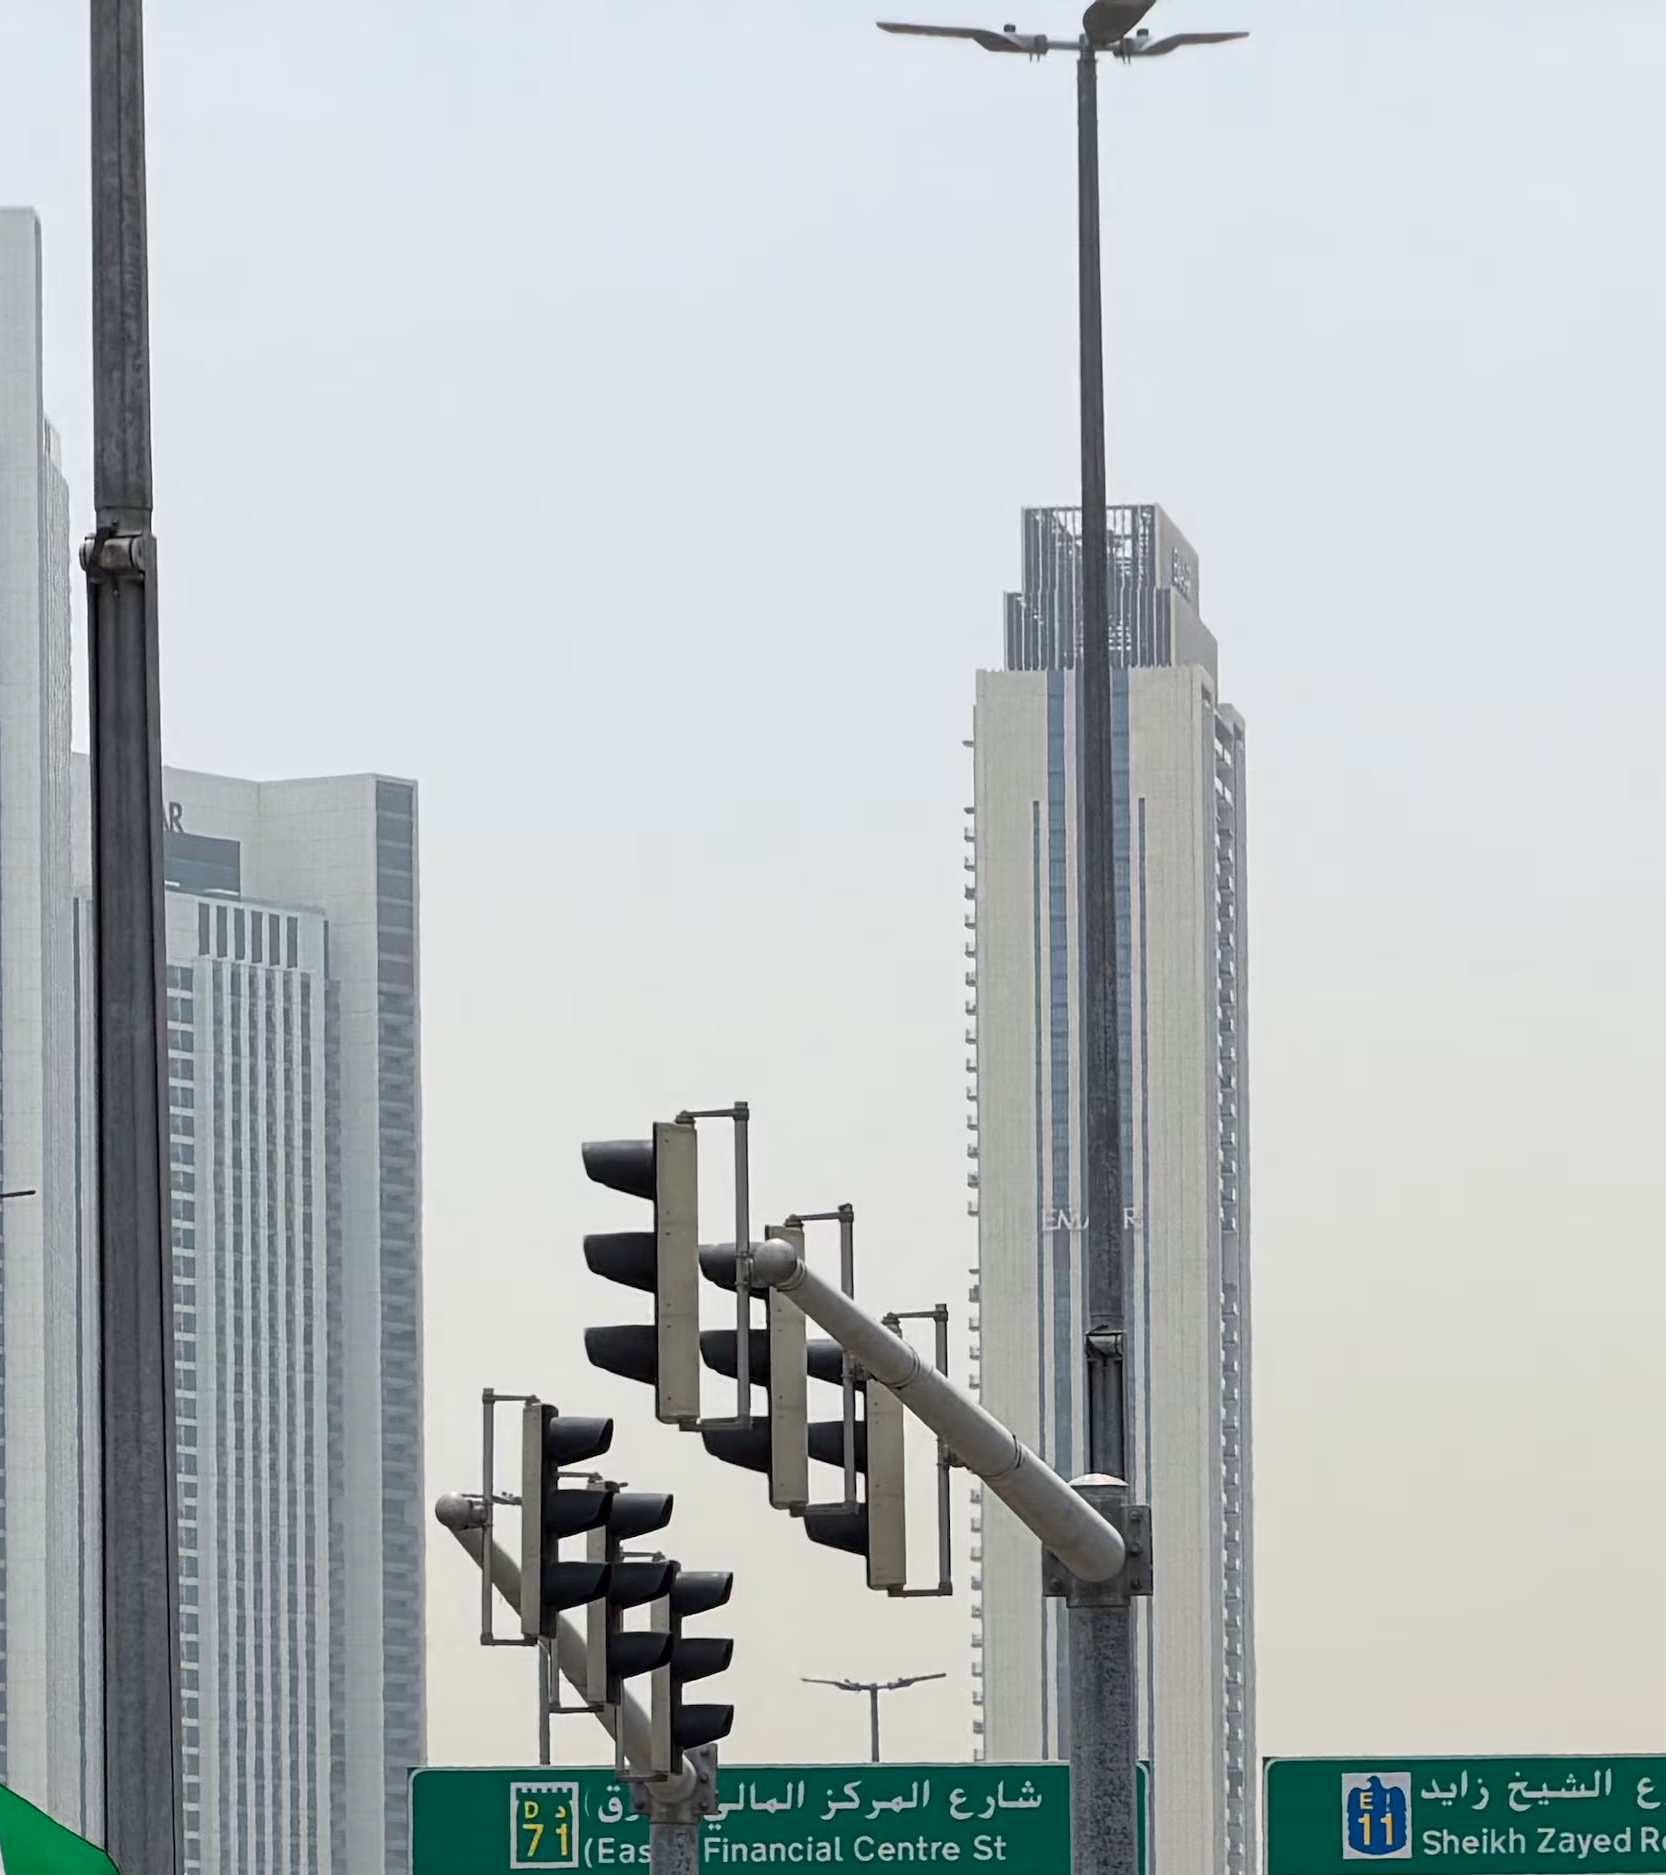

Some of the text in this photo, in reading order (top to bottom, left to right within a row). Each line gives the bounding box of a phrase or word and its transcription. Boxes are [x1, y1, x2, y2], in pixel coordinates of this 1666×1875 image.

[819, 1779, 931, 1821] المركز
[947, 1779, 1044, 1820] شارع
[1358, 1791, 1374, 1810] E
[1420, 1769, 1491, 1810] زايد
[1506, 1768, 1613, 1812] الشيخ
[523, 1800, 540, 1820] D
[522, 1822, 569, 1858] 71
[1357, 1812, 1394, 1846] 11
[1421, 1826, 1527, 1856] Sheikh
[1536, 1826, 1632, 1859] Zayed
[583, 1834, 1007, 1869] (Eas Financial Centre St
